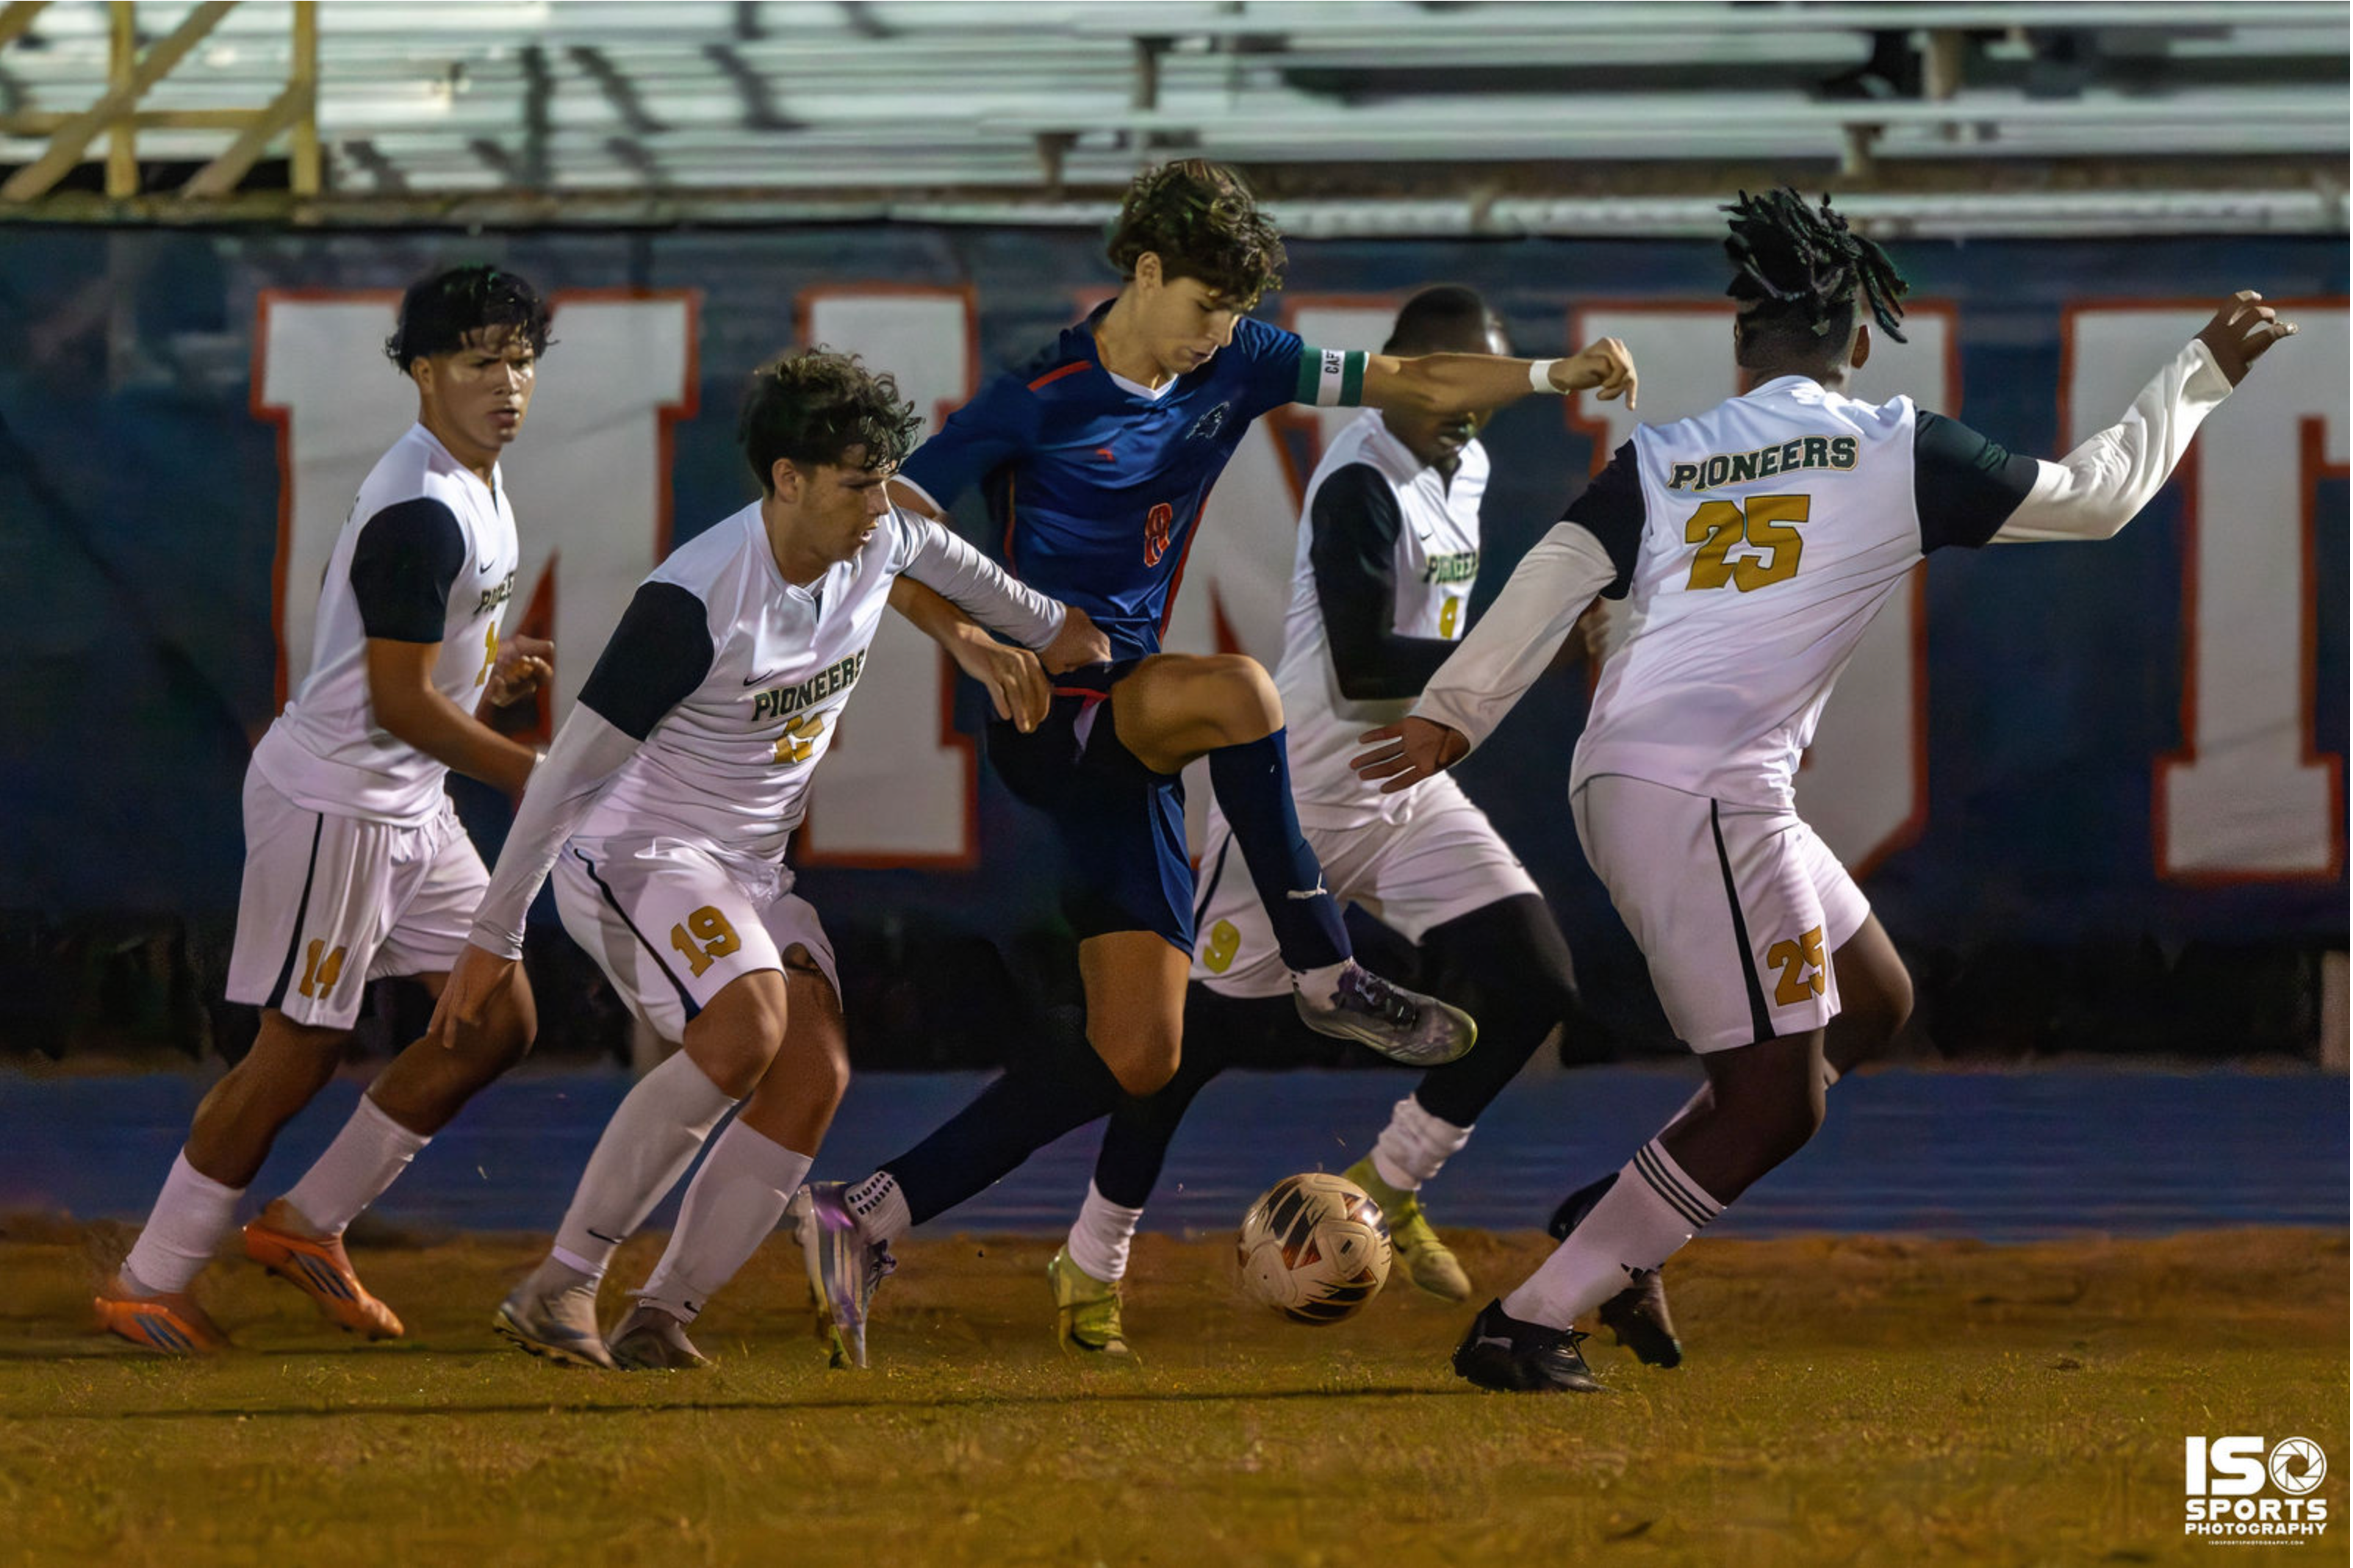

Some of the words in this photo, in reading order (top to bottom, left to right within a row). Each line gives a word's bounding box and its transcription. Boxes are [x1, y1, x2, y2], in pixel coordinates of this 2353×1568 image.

[1667, 435, 1859, 492] PIONEERS
[1144, 503, 1174, 568] 8
[1685, 494, 1811, 593] 25
[298, 938, 348, 1000] 14
[670, 905, 741, 979] 19
[1203, 918, 1240, 974] 9
[1767, 924, 1826, 1007] 25
